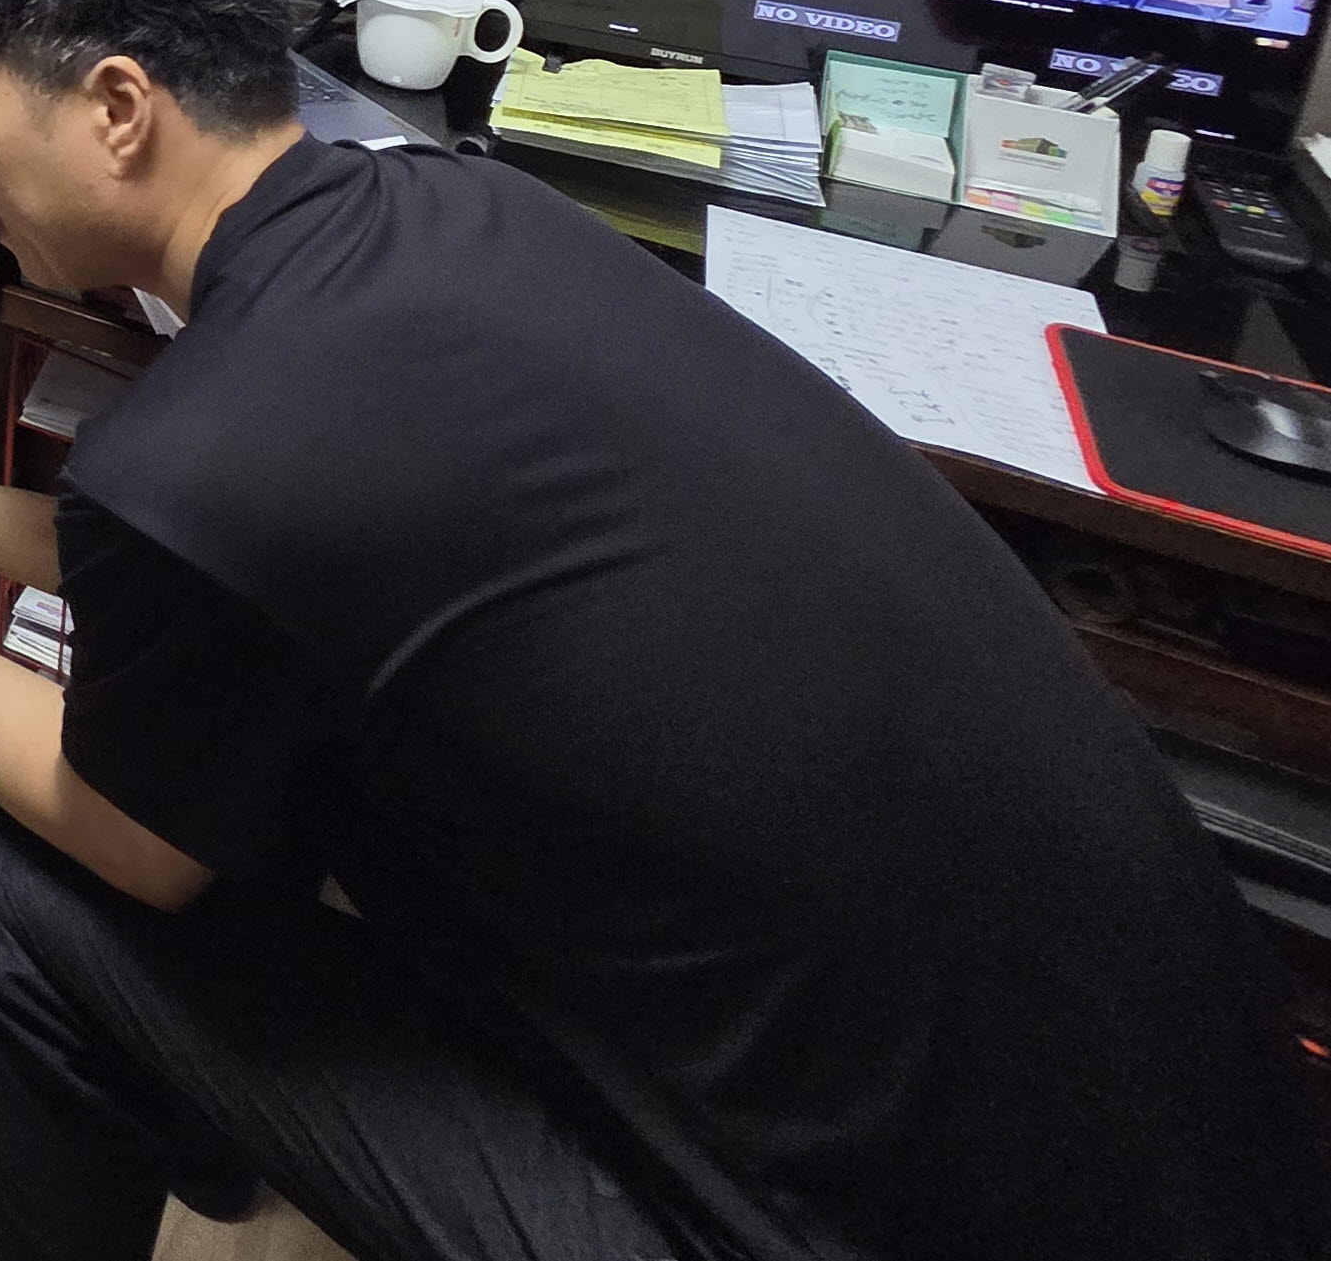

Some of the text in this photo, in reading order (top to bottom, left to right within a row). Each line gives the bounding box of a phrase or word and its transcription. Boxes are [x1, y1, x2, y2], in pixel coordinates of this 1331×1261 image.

[756, 4, 895, 38] NO VIDEO
[1052, 53, 1102, 73] NO
